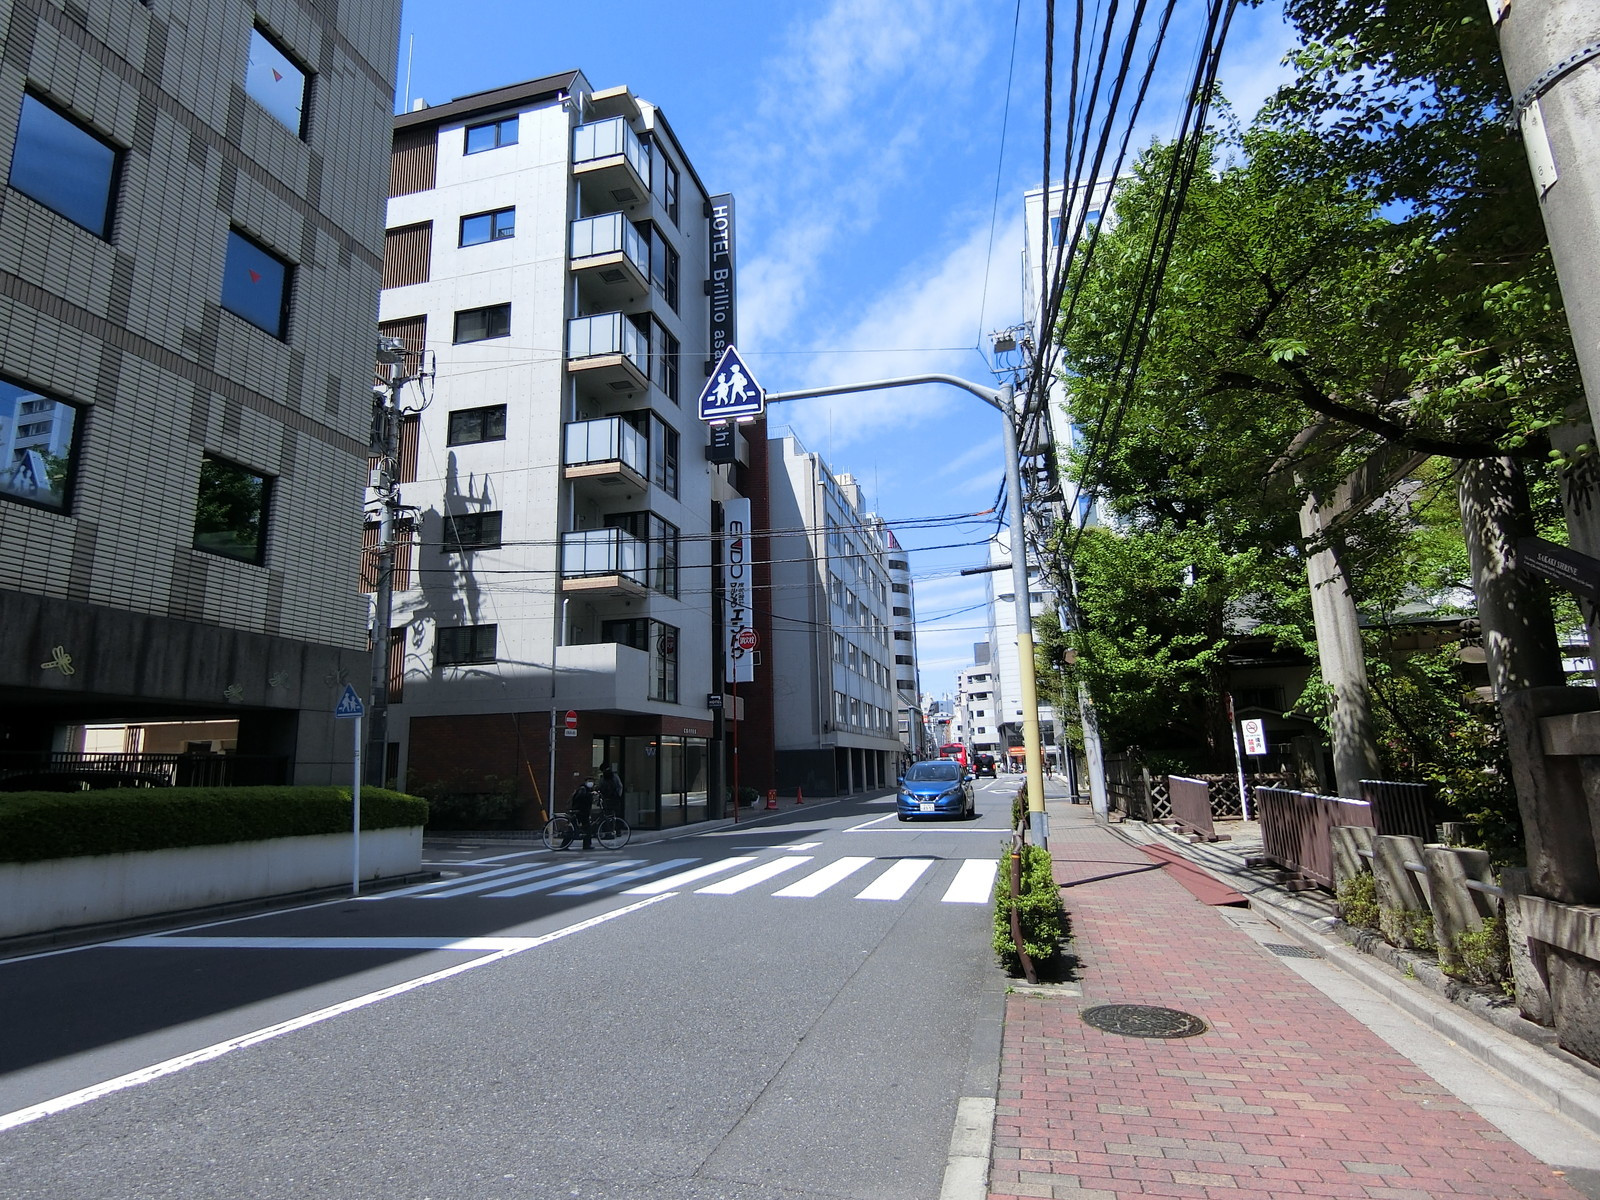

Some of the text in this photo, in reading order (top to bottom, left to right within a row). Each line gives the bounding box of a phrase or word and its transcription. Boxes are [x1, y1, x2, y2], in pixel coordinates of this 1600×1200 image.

[713, 205, 729, 262] HOTEL
[713, 268, 729, 323] Brillio
[730, 520, 743, 579] ENDO
[1556, 561, 1578, 576] SHRINE
